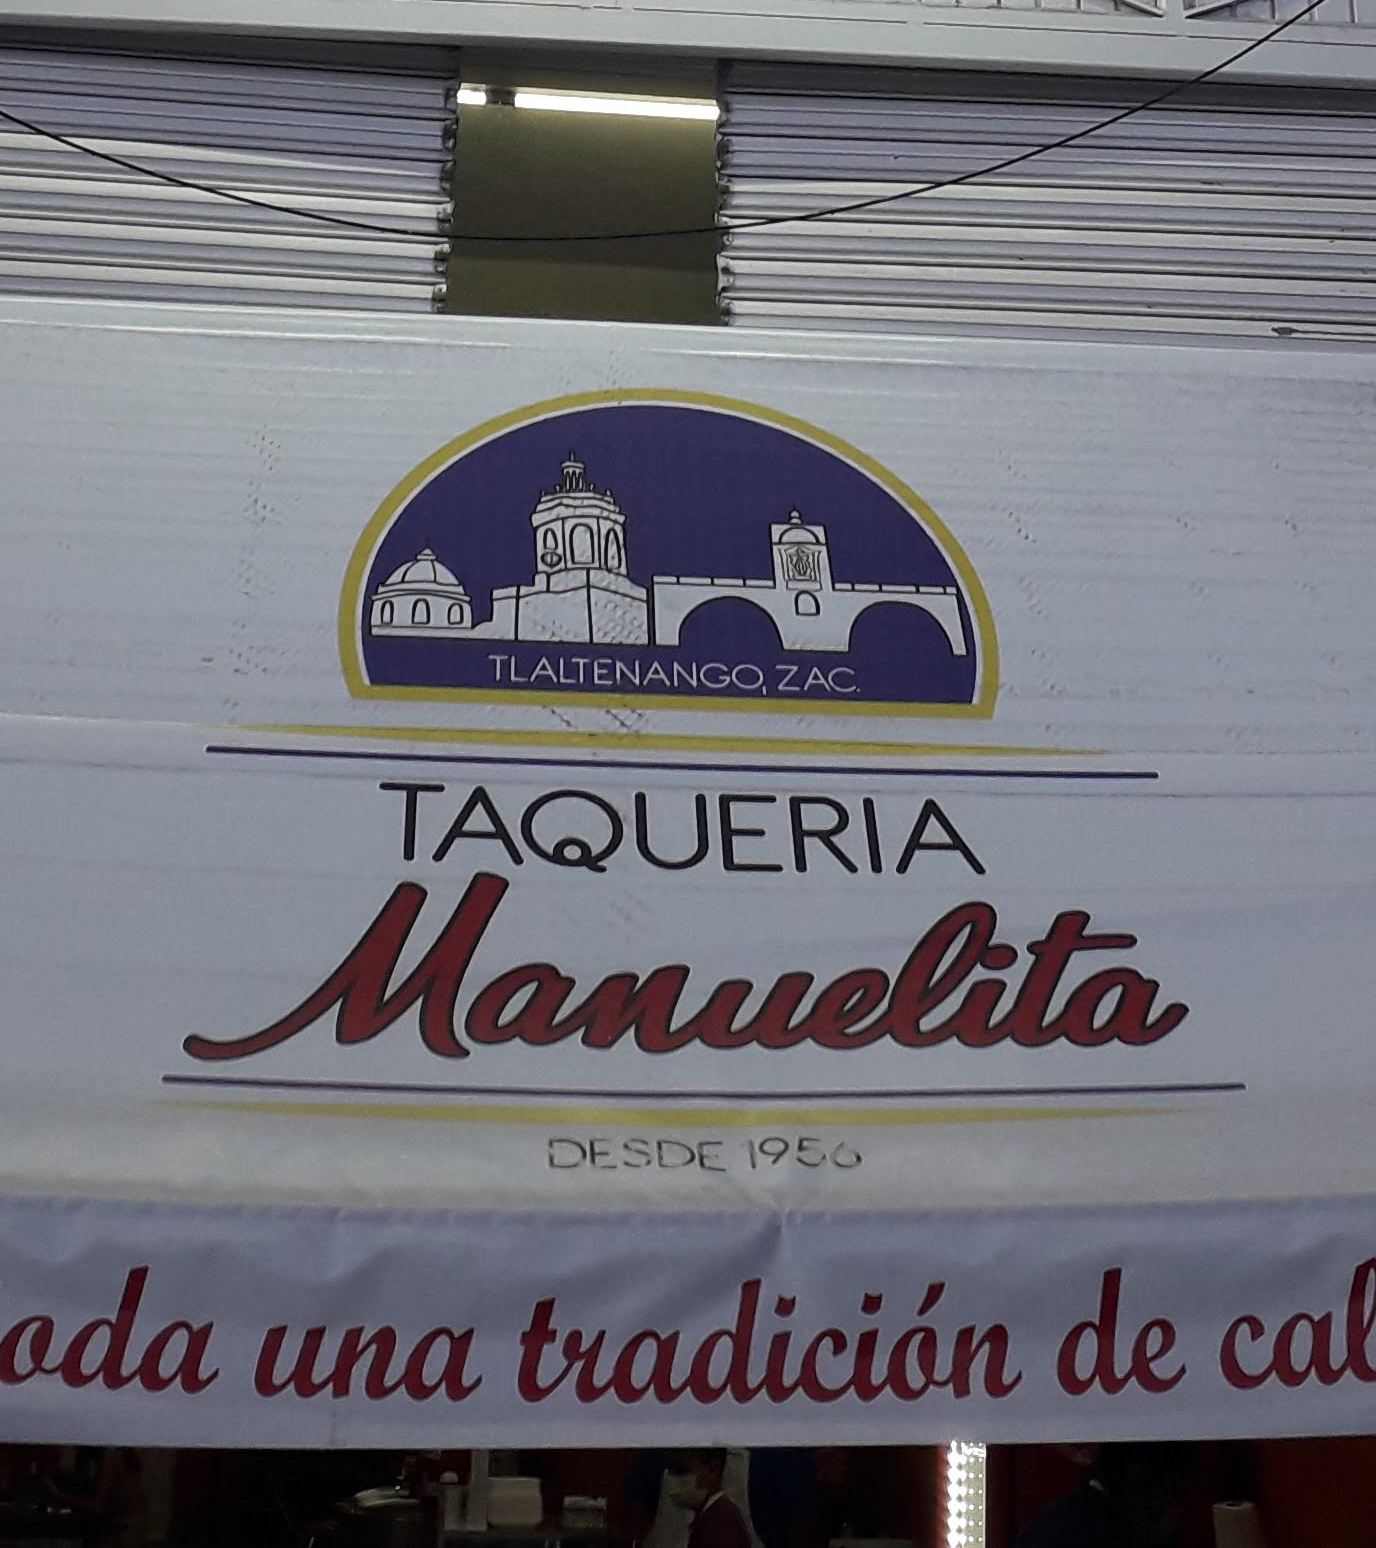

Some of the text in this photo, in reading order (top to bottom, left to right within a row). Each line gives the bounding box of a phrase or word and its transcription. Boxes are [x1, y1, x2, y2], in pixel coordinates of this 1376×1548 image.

[774, 664, 863, 694] ZAC.
[378, 780, 986, 876] TAQUERIA
[181, 870, 1191, 1061] Manuelita
[547, 1136, 864, 1172] DESDE 1956
[253, 1322, 484, 1402] una
[516, 1276, 1023, 1405] tradición
[1055, 1266, 1188, 1395] de
